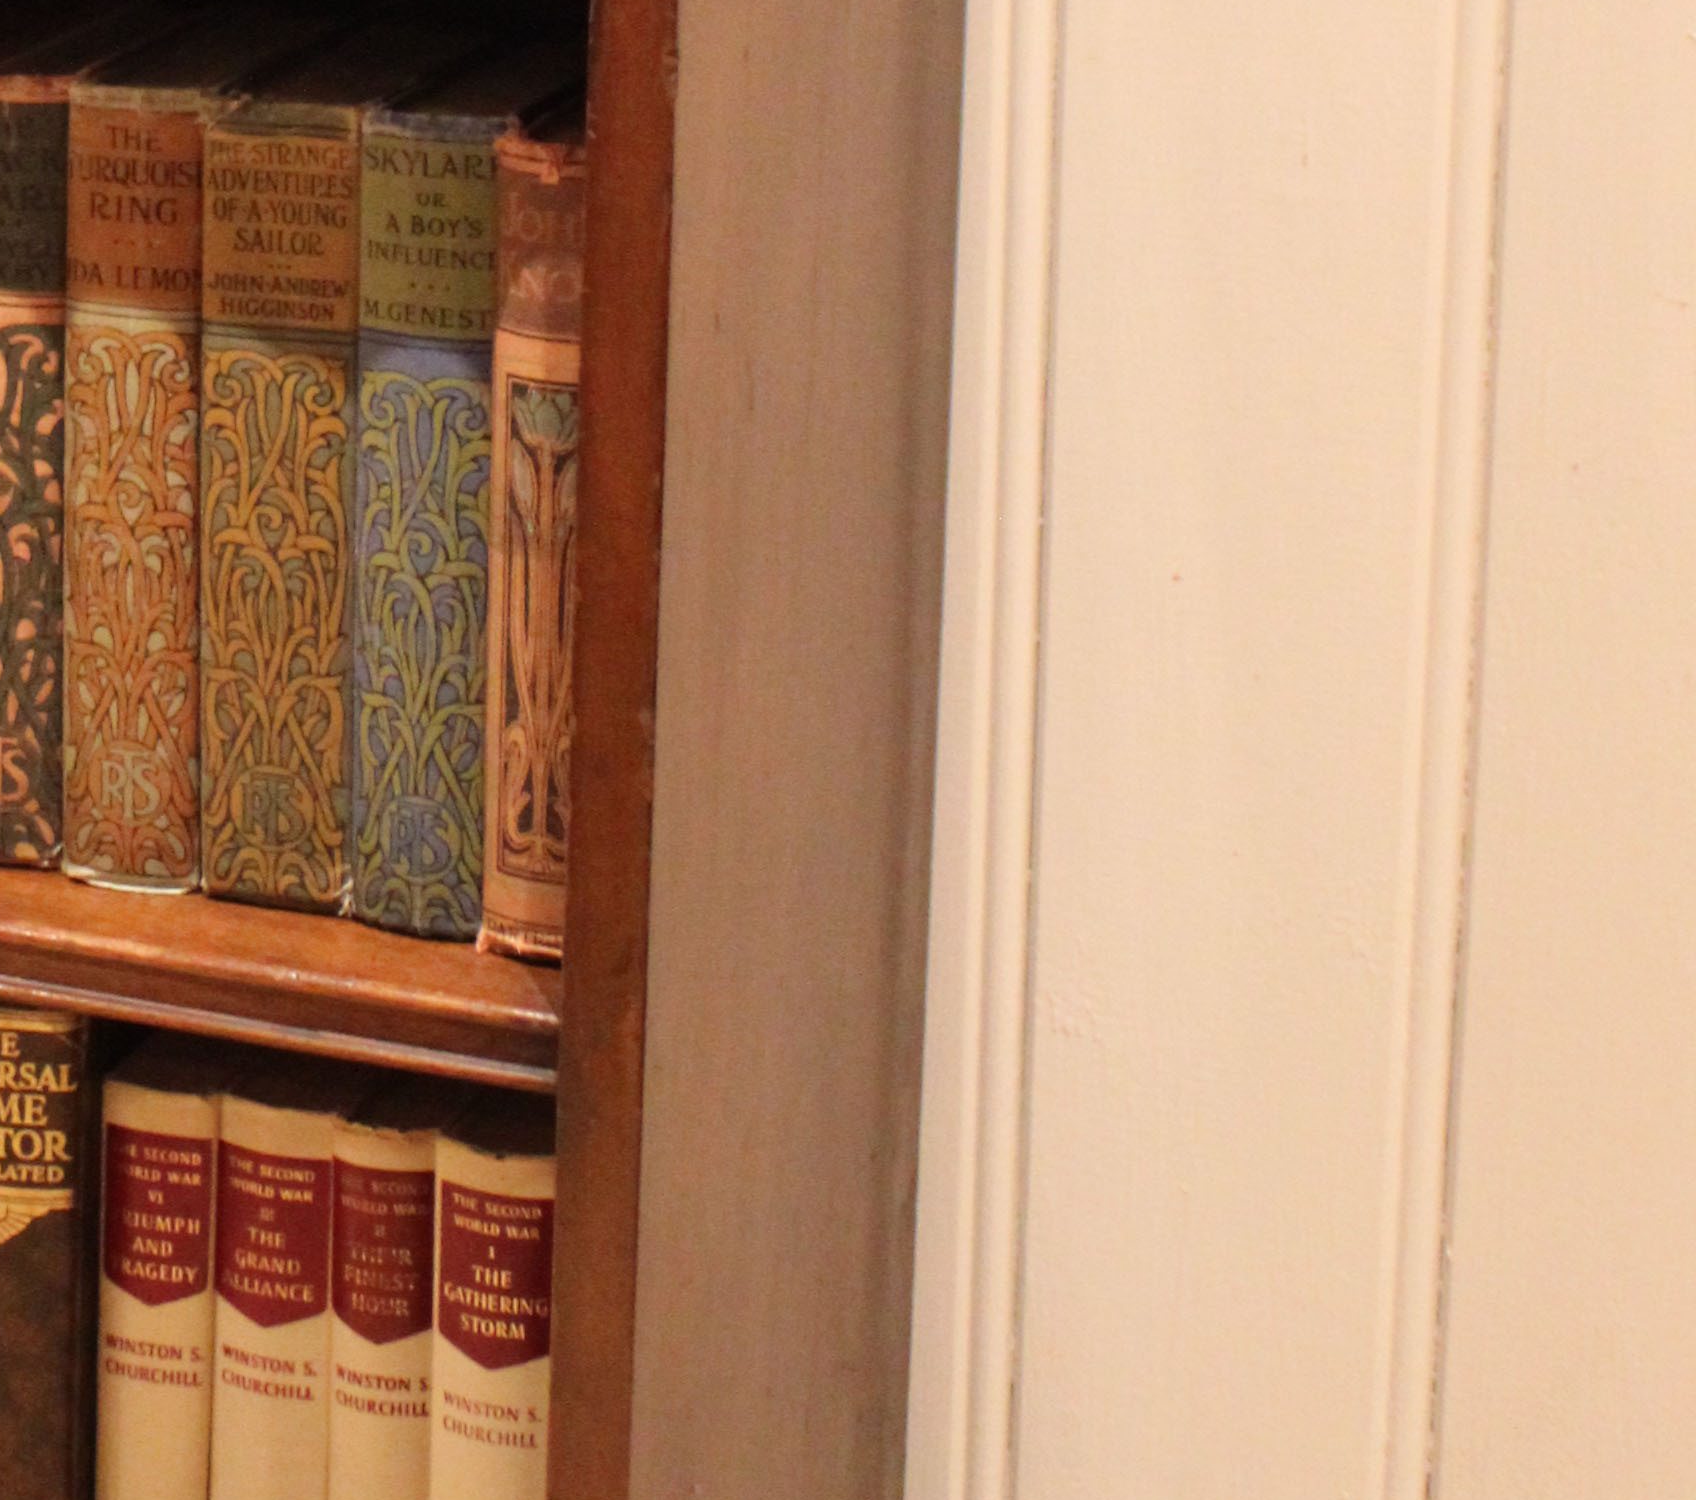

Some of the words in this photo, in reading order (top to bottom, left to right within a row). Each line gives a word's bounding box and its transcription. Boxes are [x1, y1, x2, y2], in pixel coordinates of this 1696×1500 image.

[107, 126, 161, 153] THE
[252, 143, 352, 169] STRANGE
[208, 168, 353, 199] ADVENTURES
[90, 193, 178, 225] RING
[416, 193, 445, 208] OR
[270, 202, 347, 228] YOUNG
[386, 214, 400, 234] A
[411, 213, 483, 238] BOY'S
[233, 229, 324, 256] SAILOR
[218, 299, 334, 320] HIGGINSON
[143, 1145, 202, 1167] SECOND
[126, 1164, 161, 1182] ORLD
[167, 1170, 201, 1186] WAR
[260, 1164, 316, 1184] SECOND
[279, 1188, 314, 1205] WAR
[453, 1192, 479, 1209] THE
[485, 1198, 542, 1220] SECOND
[126, 1210, 201, 1235] IUMPH
[454, 1214, 500, 1238] WORLD
[505, 1223, 540, 1241] WAR
[131, 1236, 175, 1258] AND
[247, 1226, 287, 1251] THE
[122, 1258, 200, 1285] RAGEDY
[234, 1247, 301, 1275] GRAND
[223, 1269, 315, 1304] ALLIANCE
[471, 1264, 513, 1289] THE
[443, 1281, 550, 1319] GATHERING
[459, 1314, 526, 1341] STORM
[106, 1334, 182, 1362] WINSTON
[190, 1347, 204, 1362] S.
[222, 1343, 296, 1376] WINSTON
[302, 1361, 318, 1377] S.
[105, 1358, 203, 1387] CHURCHILL
[222, 1368, 316, 1402] CHURCHILL
[335, 1363, 412, 1392] WINSTON
[335, 1388, 431, 1419] CHURCHILL
[443, 1390, 520, 1423] WINSTON
[527, 1406, 542, 1424] S.
[442, 1414, 538, 1451] CHURCHILL
